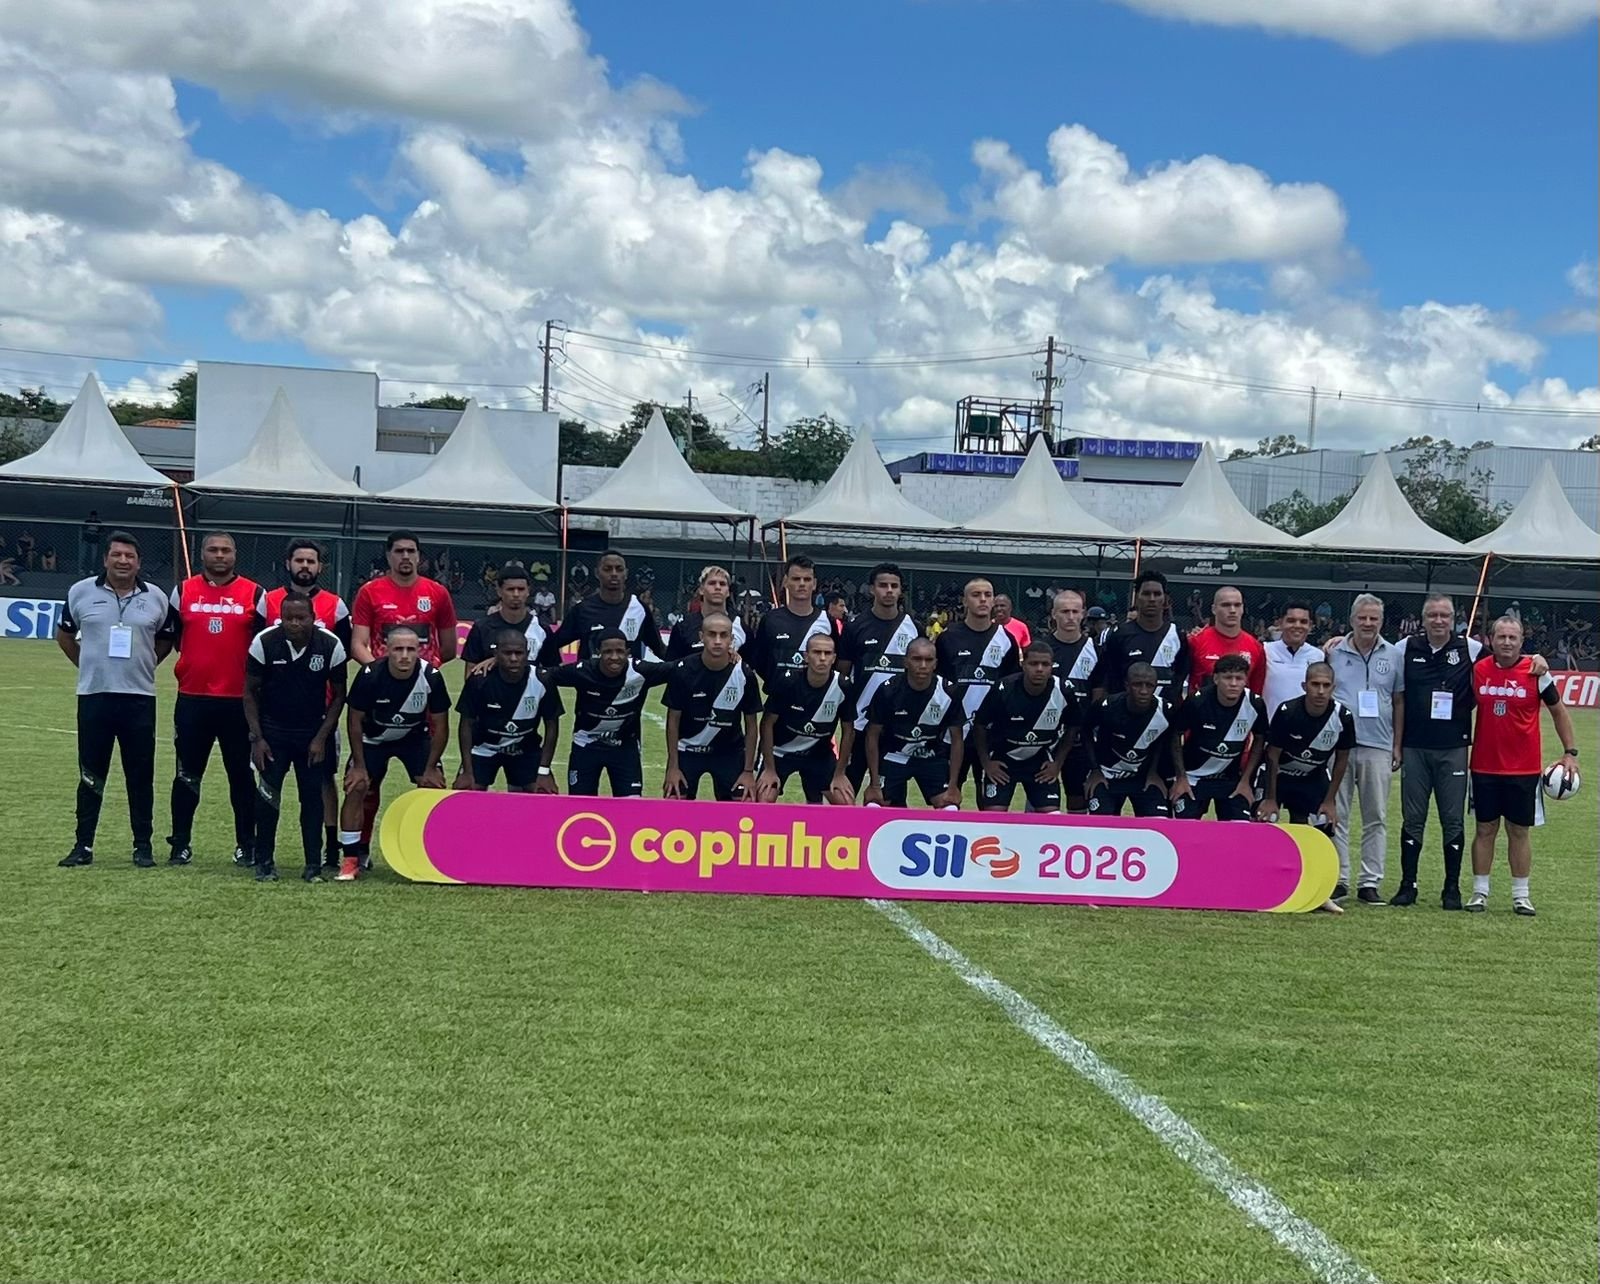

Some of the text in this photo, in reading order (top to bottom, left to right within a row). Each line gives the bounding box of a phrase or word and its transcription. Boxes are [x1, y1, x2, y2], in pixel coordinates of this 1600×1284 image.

[630, 817, 1148, 882] copinha Sil 2026
